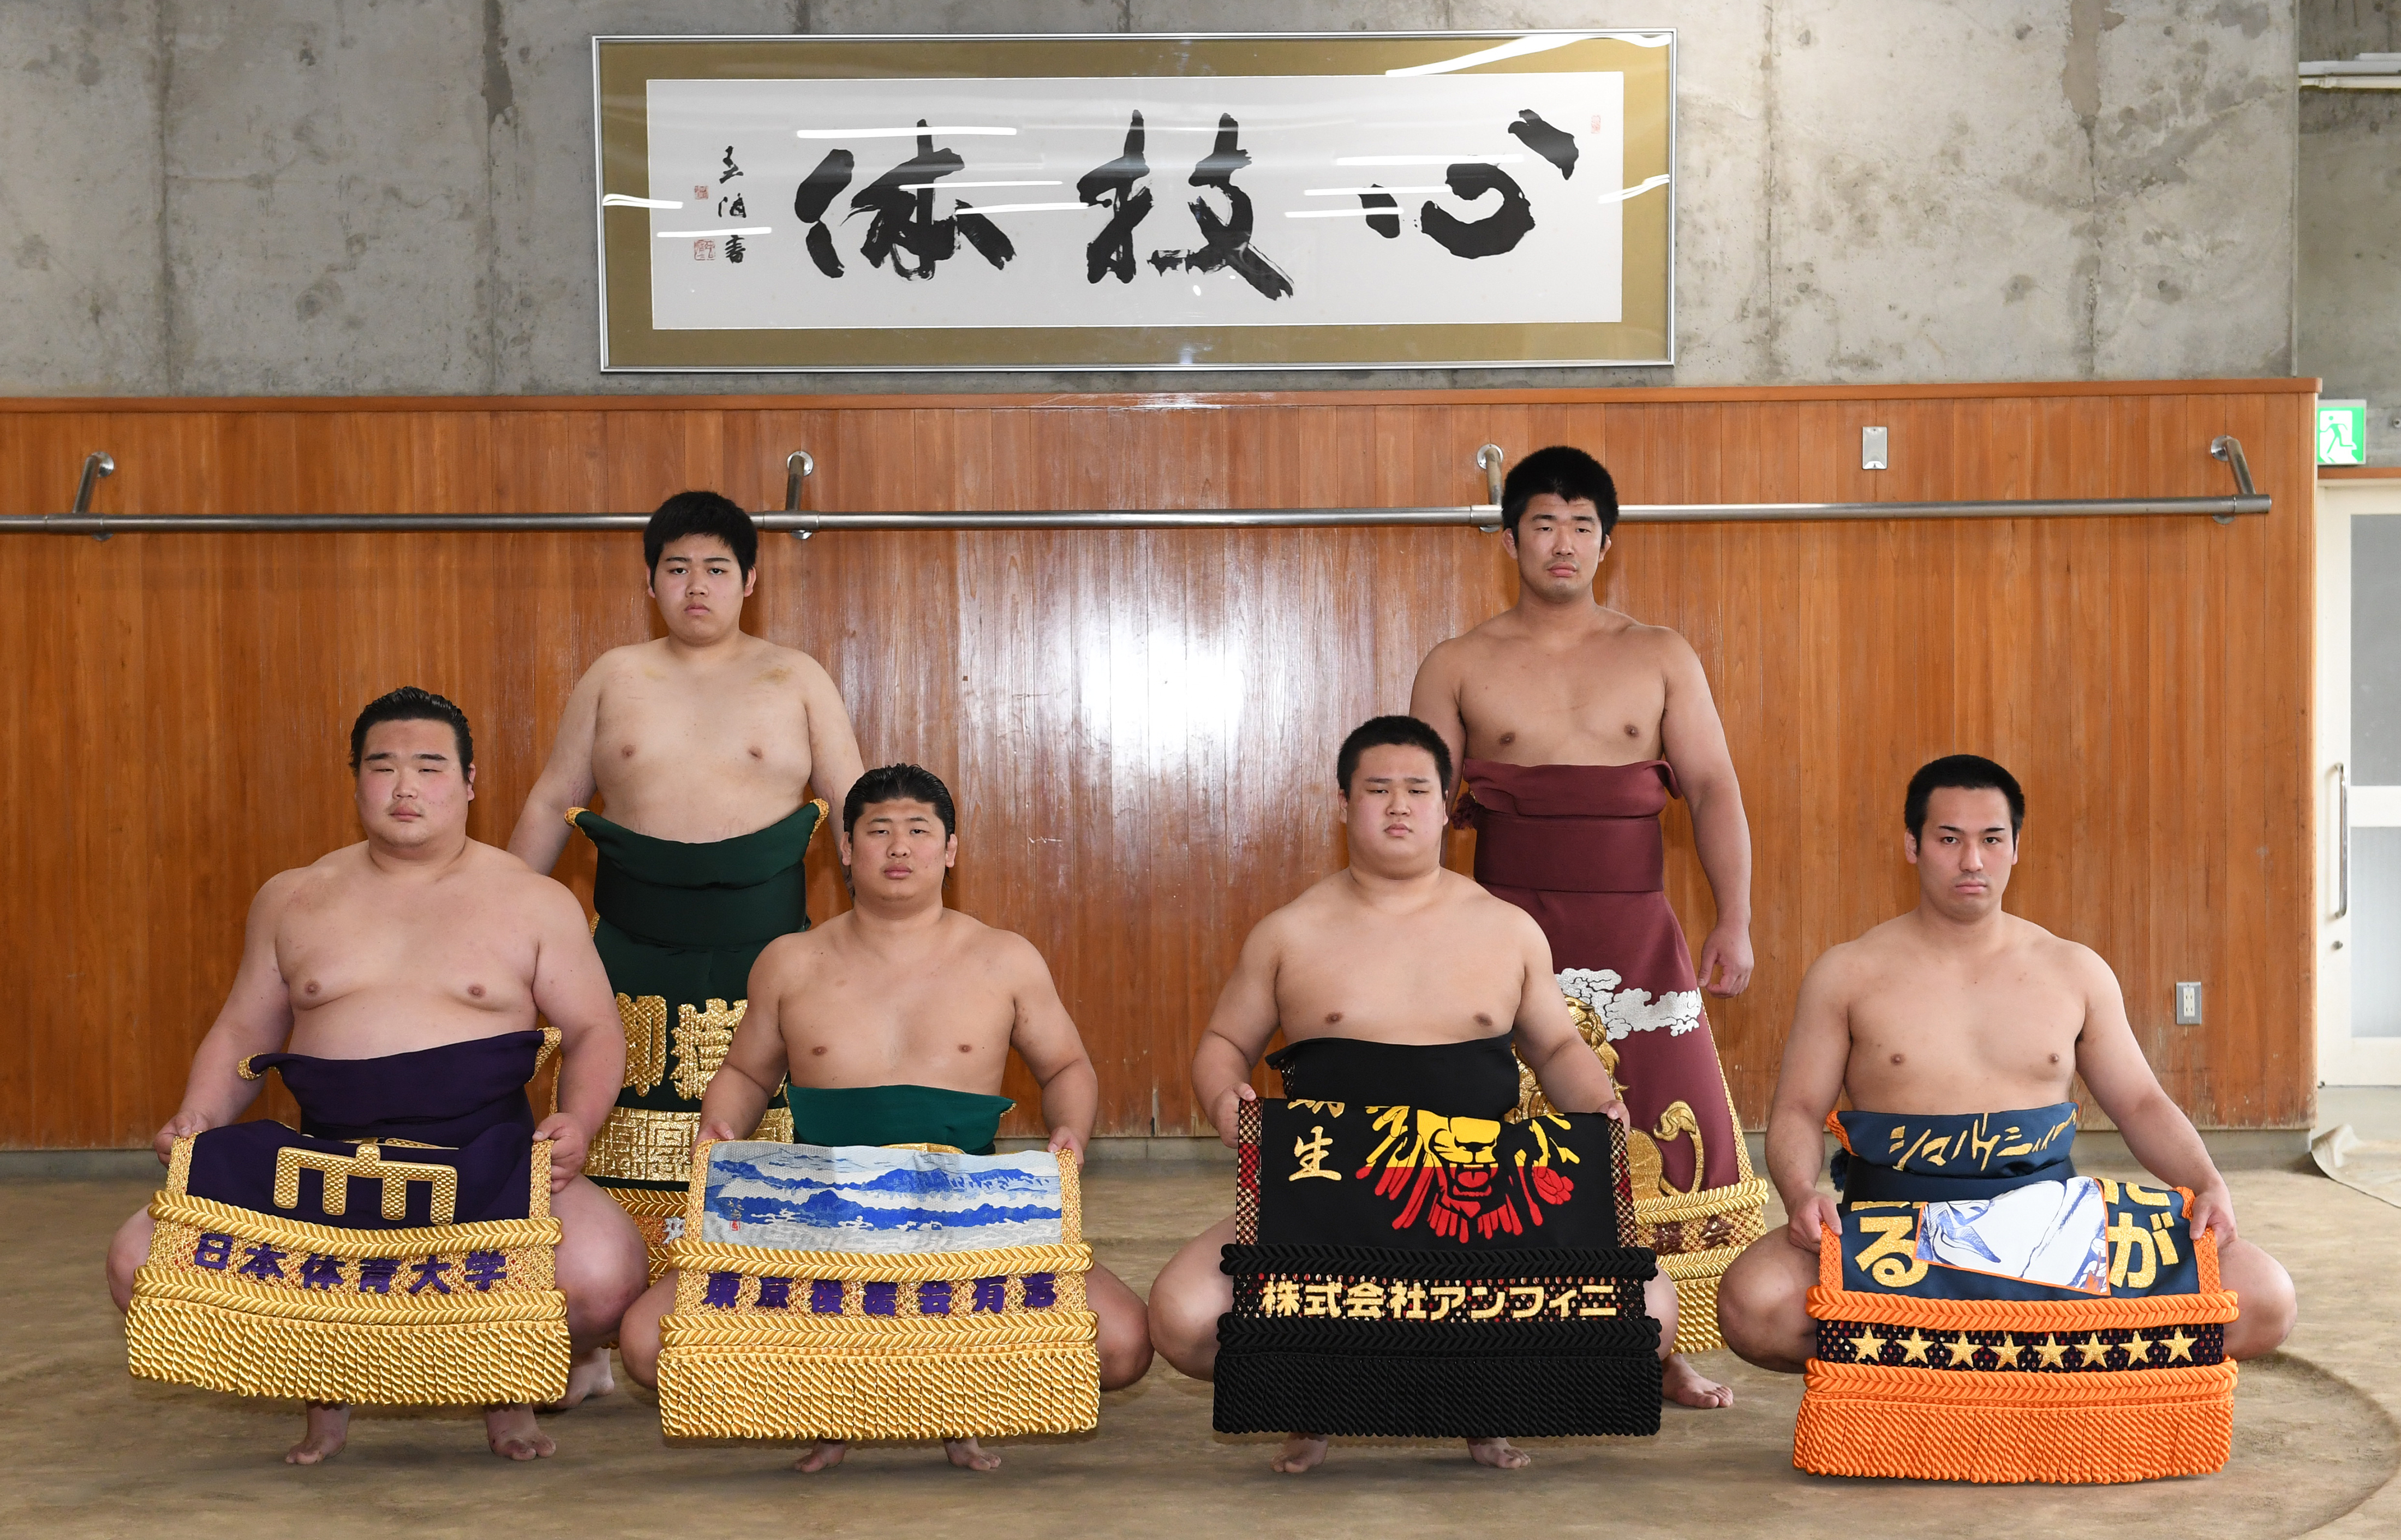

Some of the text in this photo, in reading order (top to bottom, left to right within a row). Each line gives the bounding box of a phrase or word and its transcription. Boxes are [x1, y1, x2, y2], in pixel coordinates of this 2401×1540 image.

[194, 1232, 507, 1294] 日本体育大学
[1851, 1201, 1930, 1288] る
[1262, 1280, 1617, 1321] 株式会社アンフィニ
